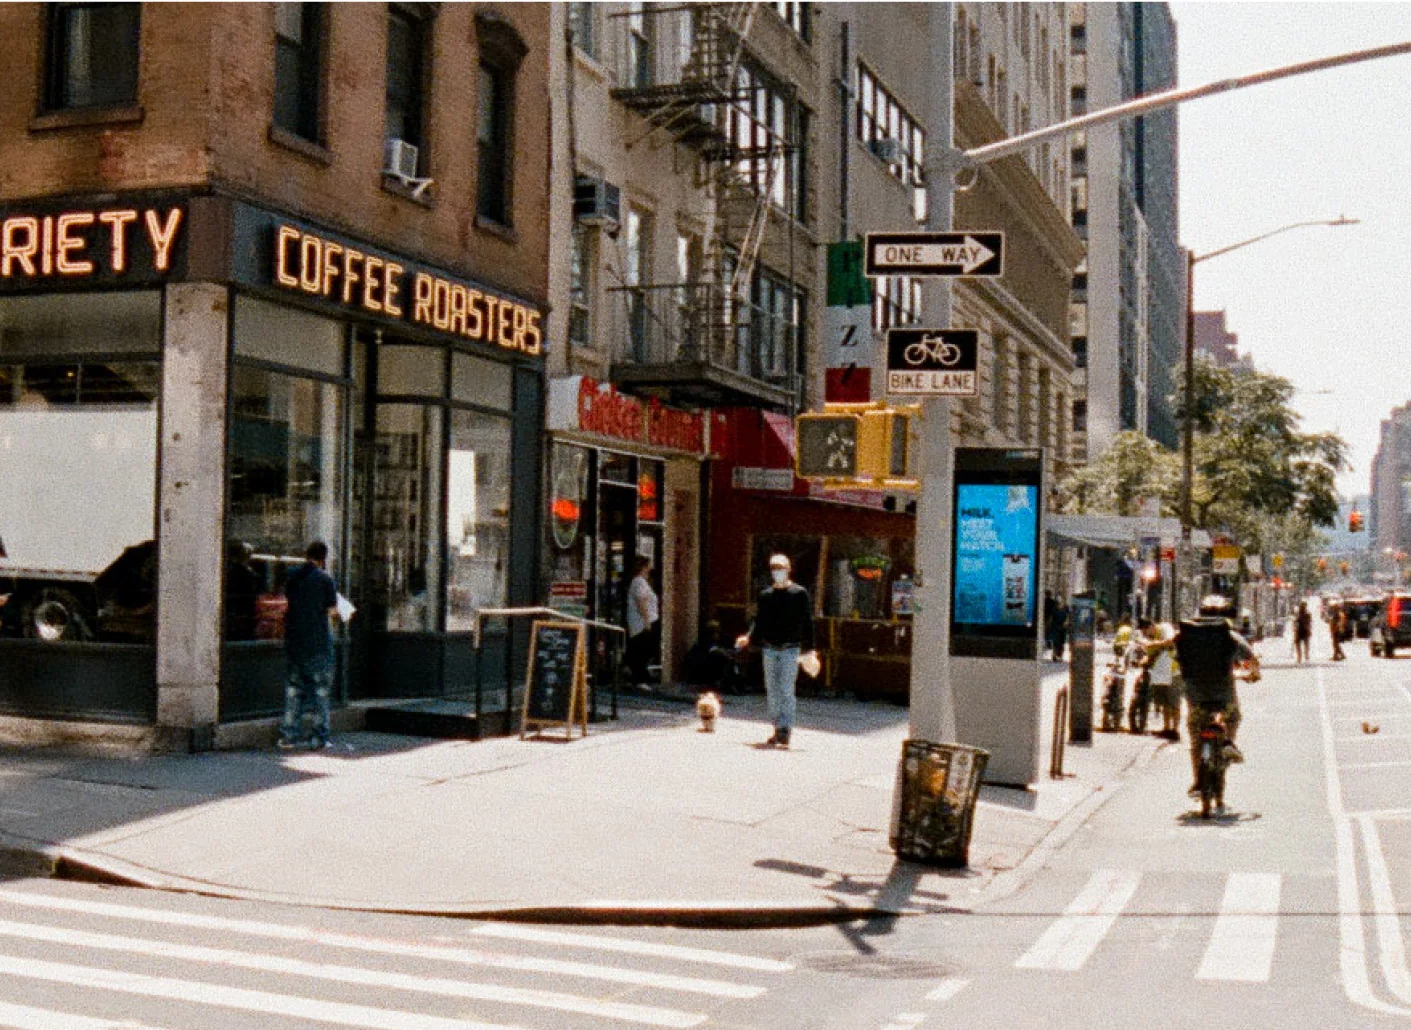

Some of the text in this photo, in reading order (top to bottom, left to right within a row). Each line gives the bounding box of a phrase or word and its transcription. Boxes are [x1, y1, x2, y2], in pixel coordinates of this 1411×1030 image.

[885, 246, 982, 263] ONE WAY
[278, 224, 542, 355] COFFEE ROASTERS
[891, 373, 972, 389] BIKE LANE
